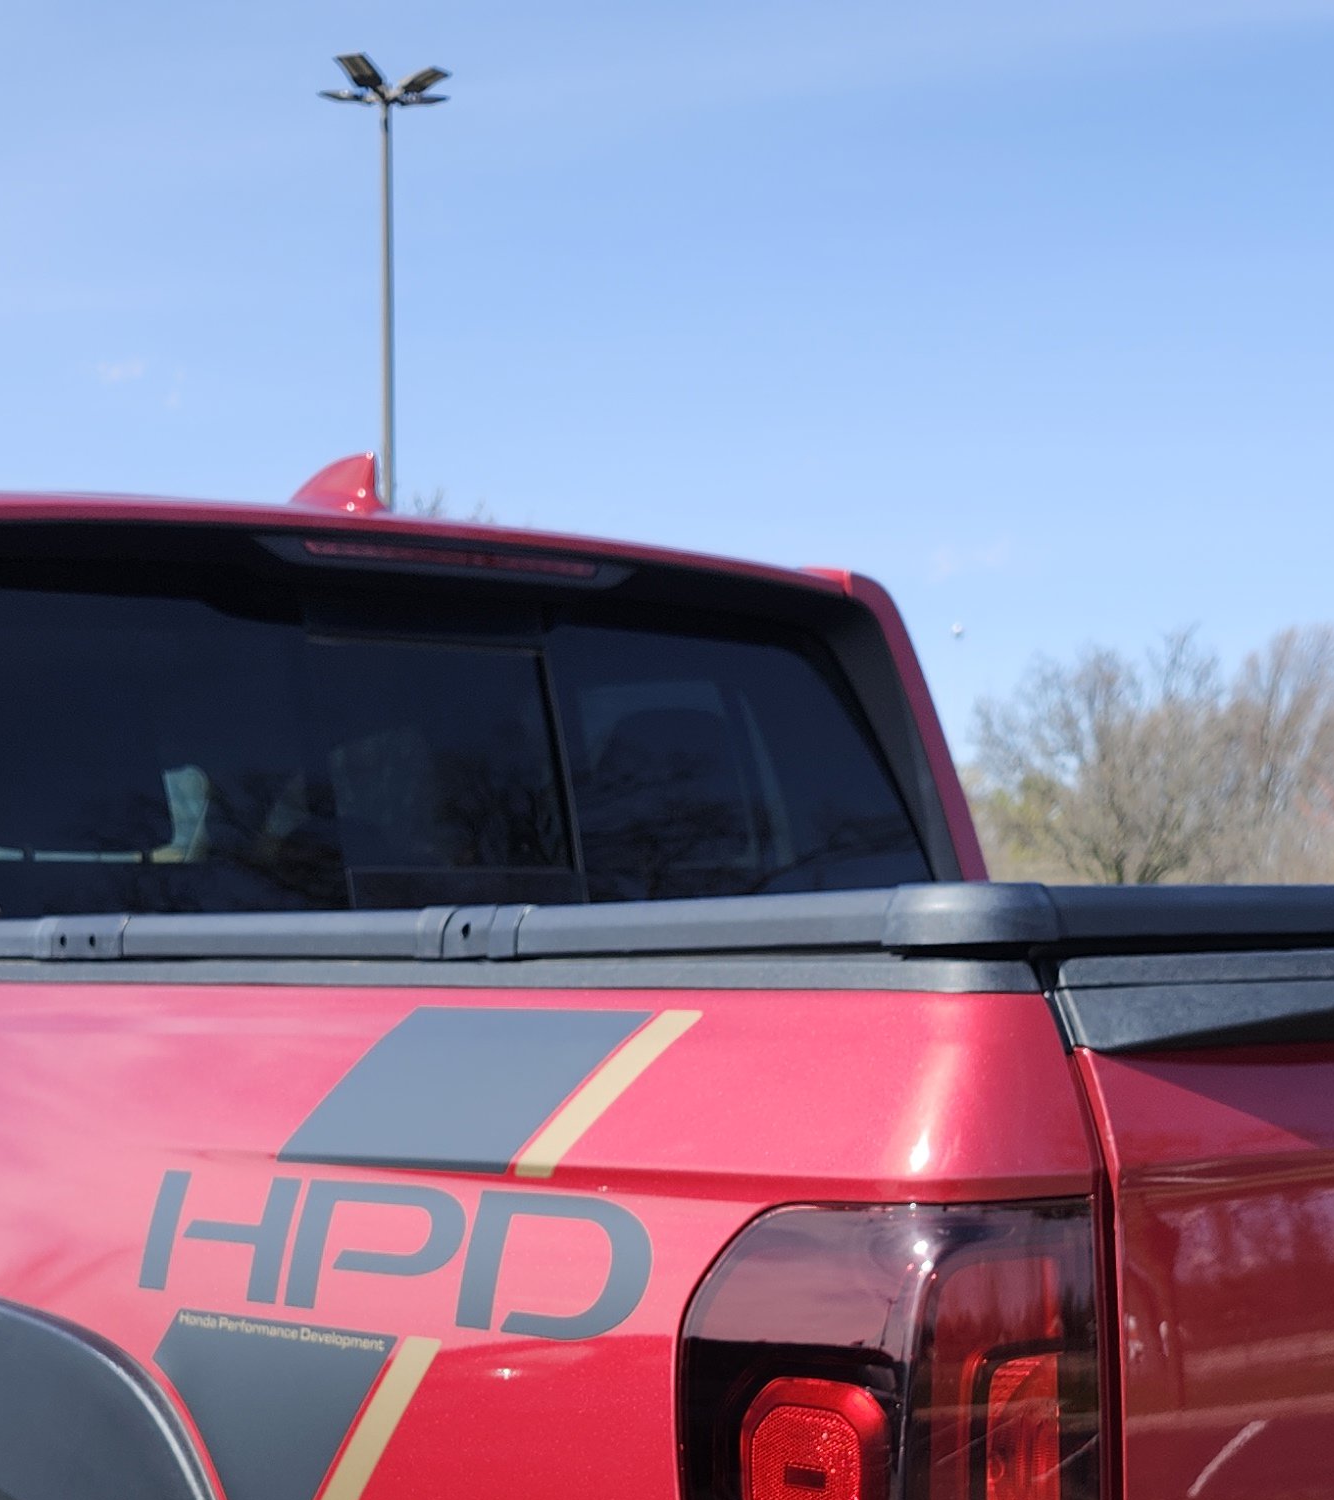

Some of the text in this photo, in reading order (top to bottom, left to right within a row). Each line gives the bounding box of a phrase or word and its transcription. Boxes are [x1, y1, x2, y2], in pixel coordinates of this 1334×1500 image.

[137, 1169, 654, 1341] HPD
[178, 1312, 386, 1352] Honda Performance Development
